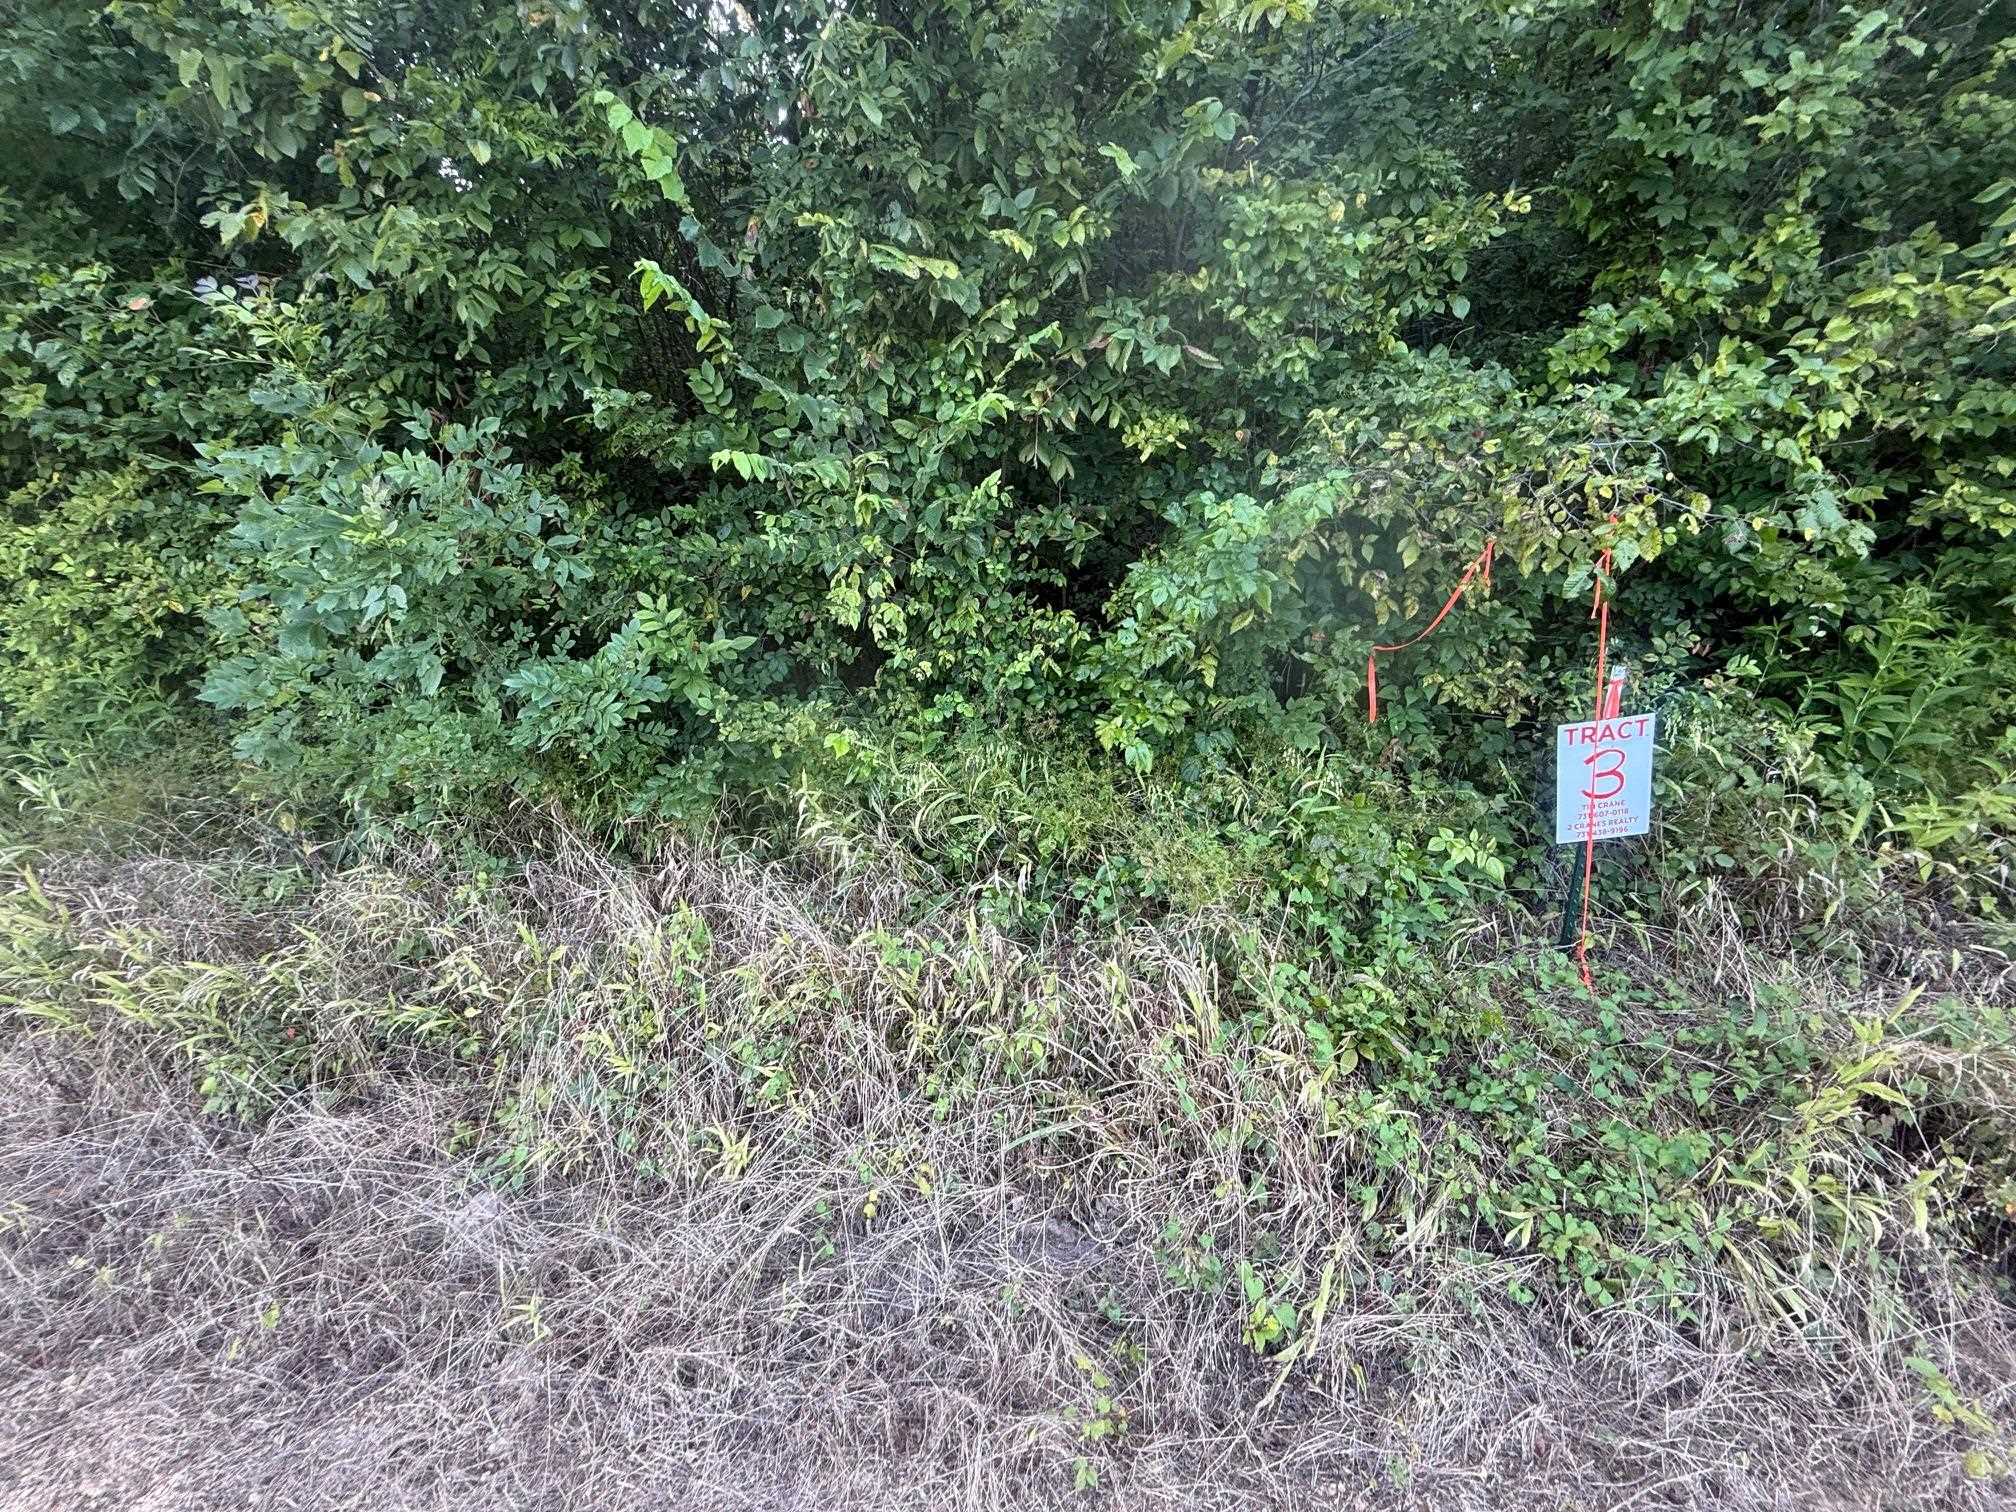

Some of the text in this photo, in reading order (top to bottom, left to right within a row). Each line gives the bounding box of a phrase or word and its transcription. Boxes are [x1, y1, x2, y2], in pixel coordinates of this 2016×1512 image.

[1564, 718, 1649, 745] TRACT
[1582, 748, 1626, 799] 3
[1597, 800, 1626, 809] CRANE
[1577, 809, 1629, 820] 731607-0118
[1608, 815, 1639, 826] REALTY
